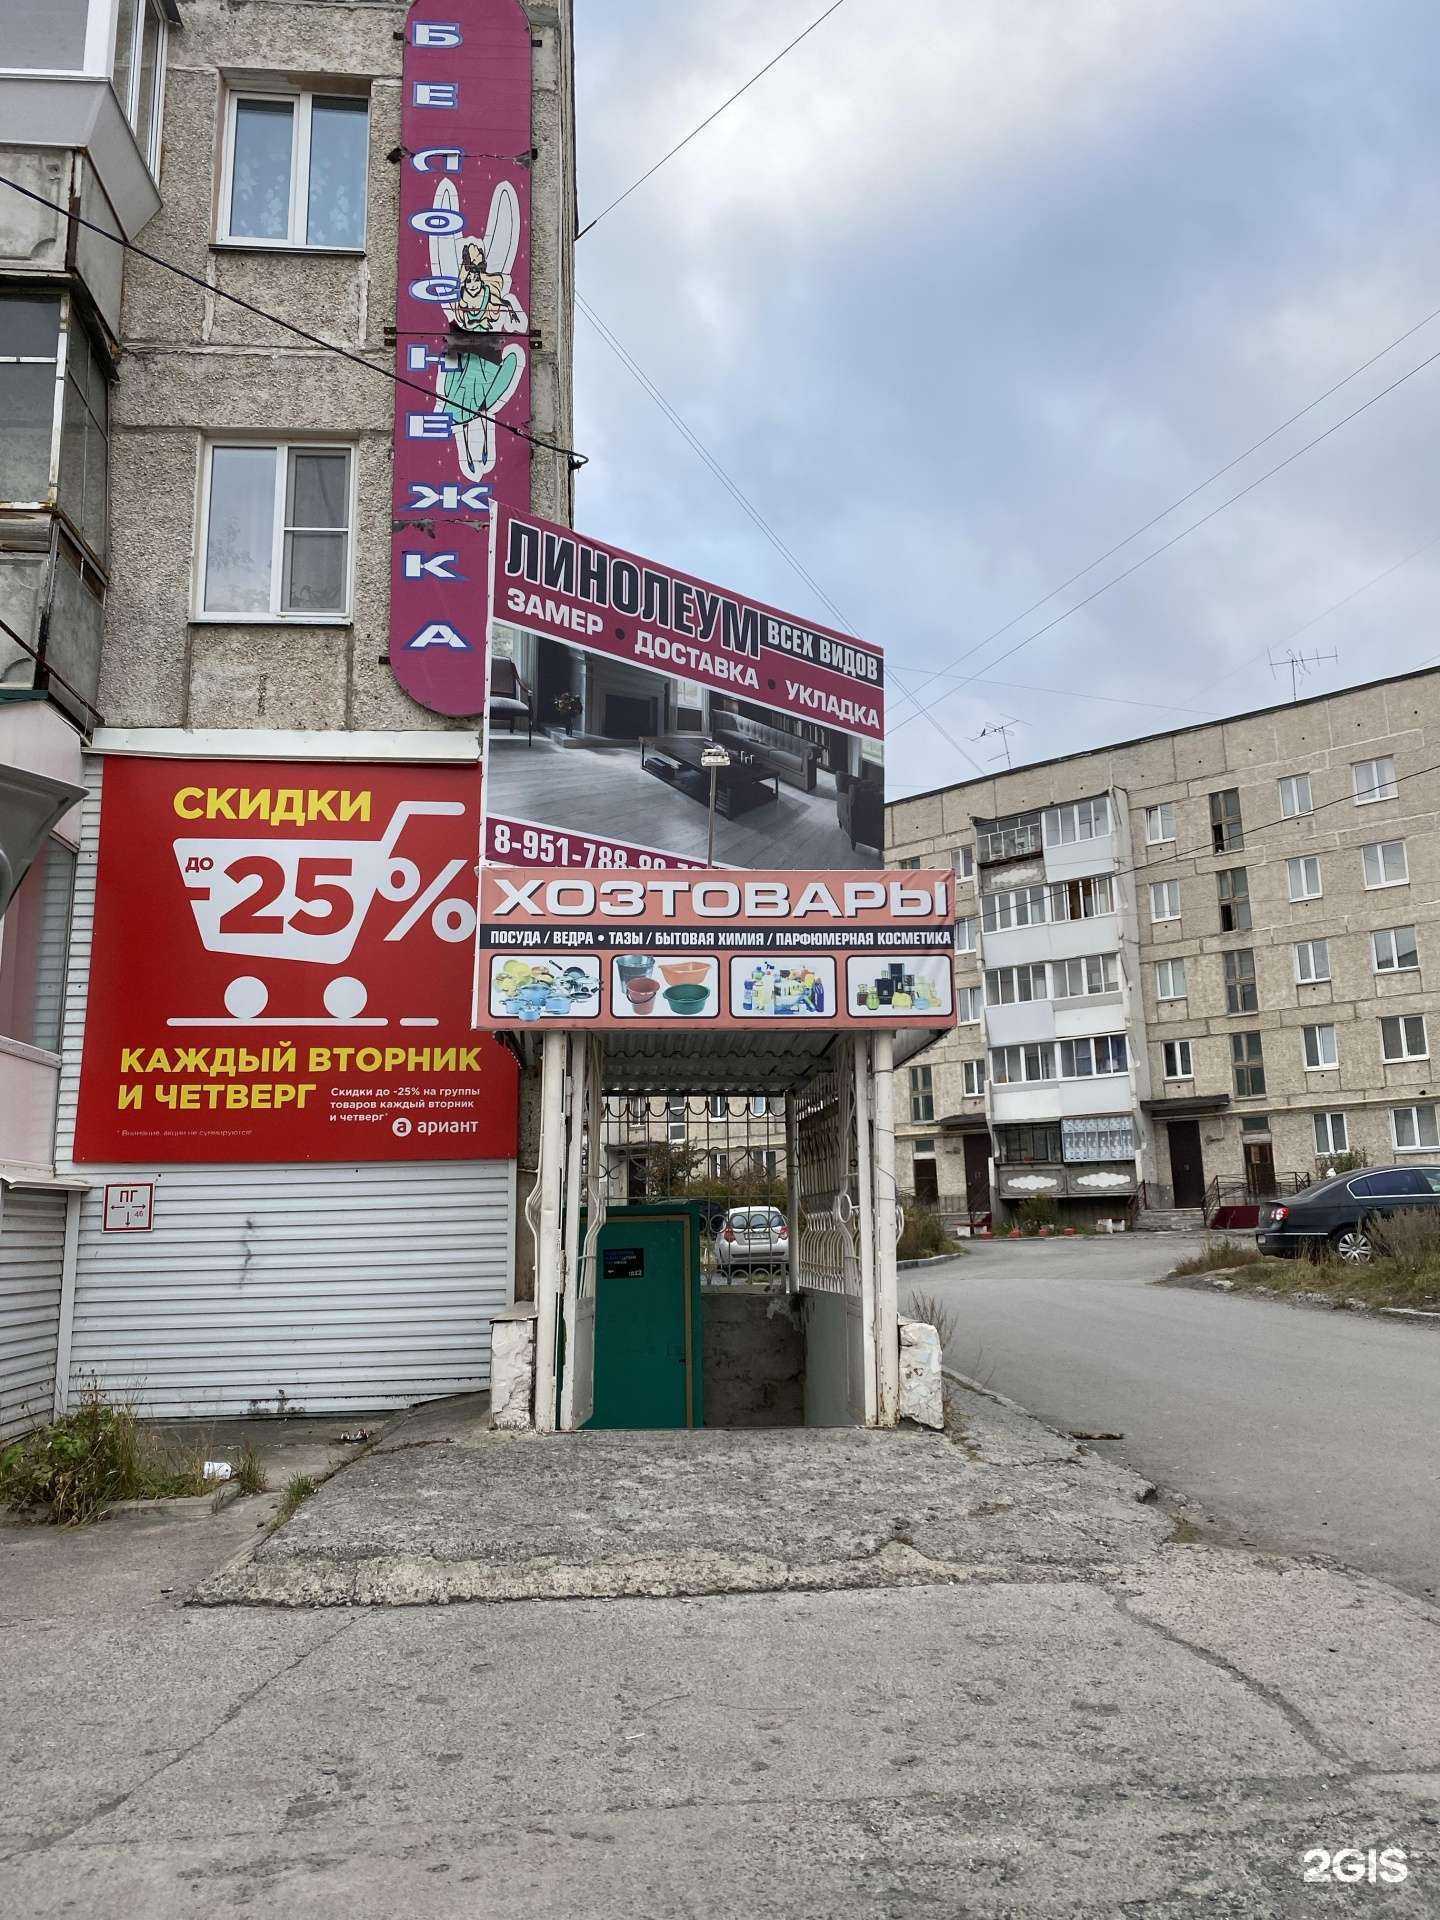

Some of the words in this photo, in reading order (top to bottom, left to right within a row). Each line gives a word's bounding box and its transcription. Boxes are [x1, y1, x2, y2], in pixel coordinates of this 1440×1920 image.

[505, 518, 760, 660] ЛИНОЛЕУМ
[507, 587, 604, 638] ЗАМЕР
[634, 630, 760, 691] ДОСТАВКА
[785, 679, 881, 730] УКЛАДКА
[767, 619, 814, 659] ВСЕХ
[819, 640, 879, 682] ВИДОВ
[173, 787, 372, 826] СКИДКИ
[493, 878, 949, 918] ХОЗТОВАРЫ
[490, 931, 541, 946] ПОСУДА
[553, 931, 594, 946] ВЕДРА
[608, 931, 643, 945] ТАЗЫ
[655, 932, 715, 946] БЫТОВАЯ
[718, 932, 763, 946] ХИМИЯ
[776, 932, 874, 946] ПАРФЮМЕРНАЯ
[877, 931, 952, 945] КОСМЕТИКА
[120, 1041, 297, 1076] КАЖДЫЙ
[308, 1047, 482, 1072] ВТОРНИК
[117, 1085, 142, 1110] И
[154, 1083, 317, 1110] ЧЕТВЕРГ
[330, 1101, 377, 1111] товаров
[379, 1099, 426, 1110] каждый
[428, 1100, 475, 1111] вторник
[331, 1087, 373, 1098] Скидки
[375, 1088, 390, 1098] до
[393, 1087, 420, 1096] -25%
[423, 1088, 437, 1096] на
[439, 1087, 481, 1100] группы
[329, 1113, 337, 1122] и
[417, 1120, 479, 1136] ариант
[119, 1190, 138, 1203] ПГ
